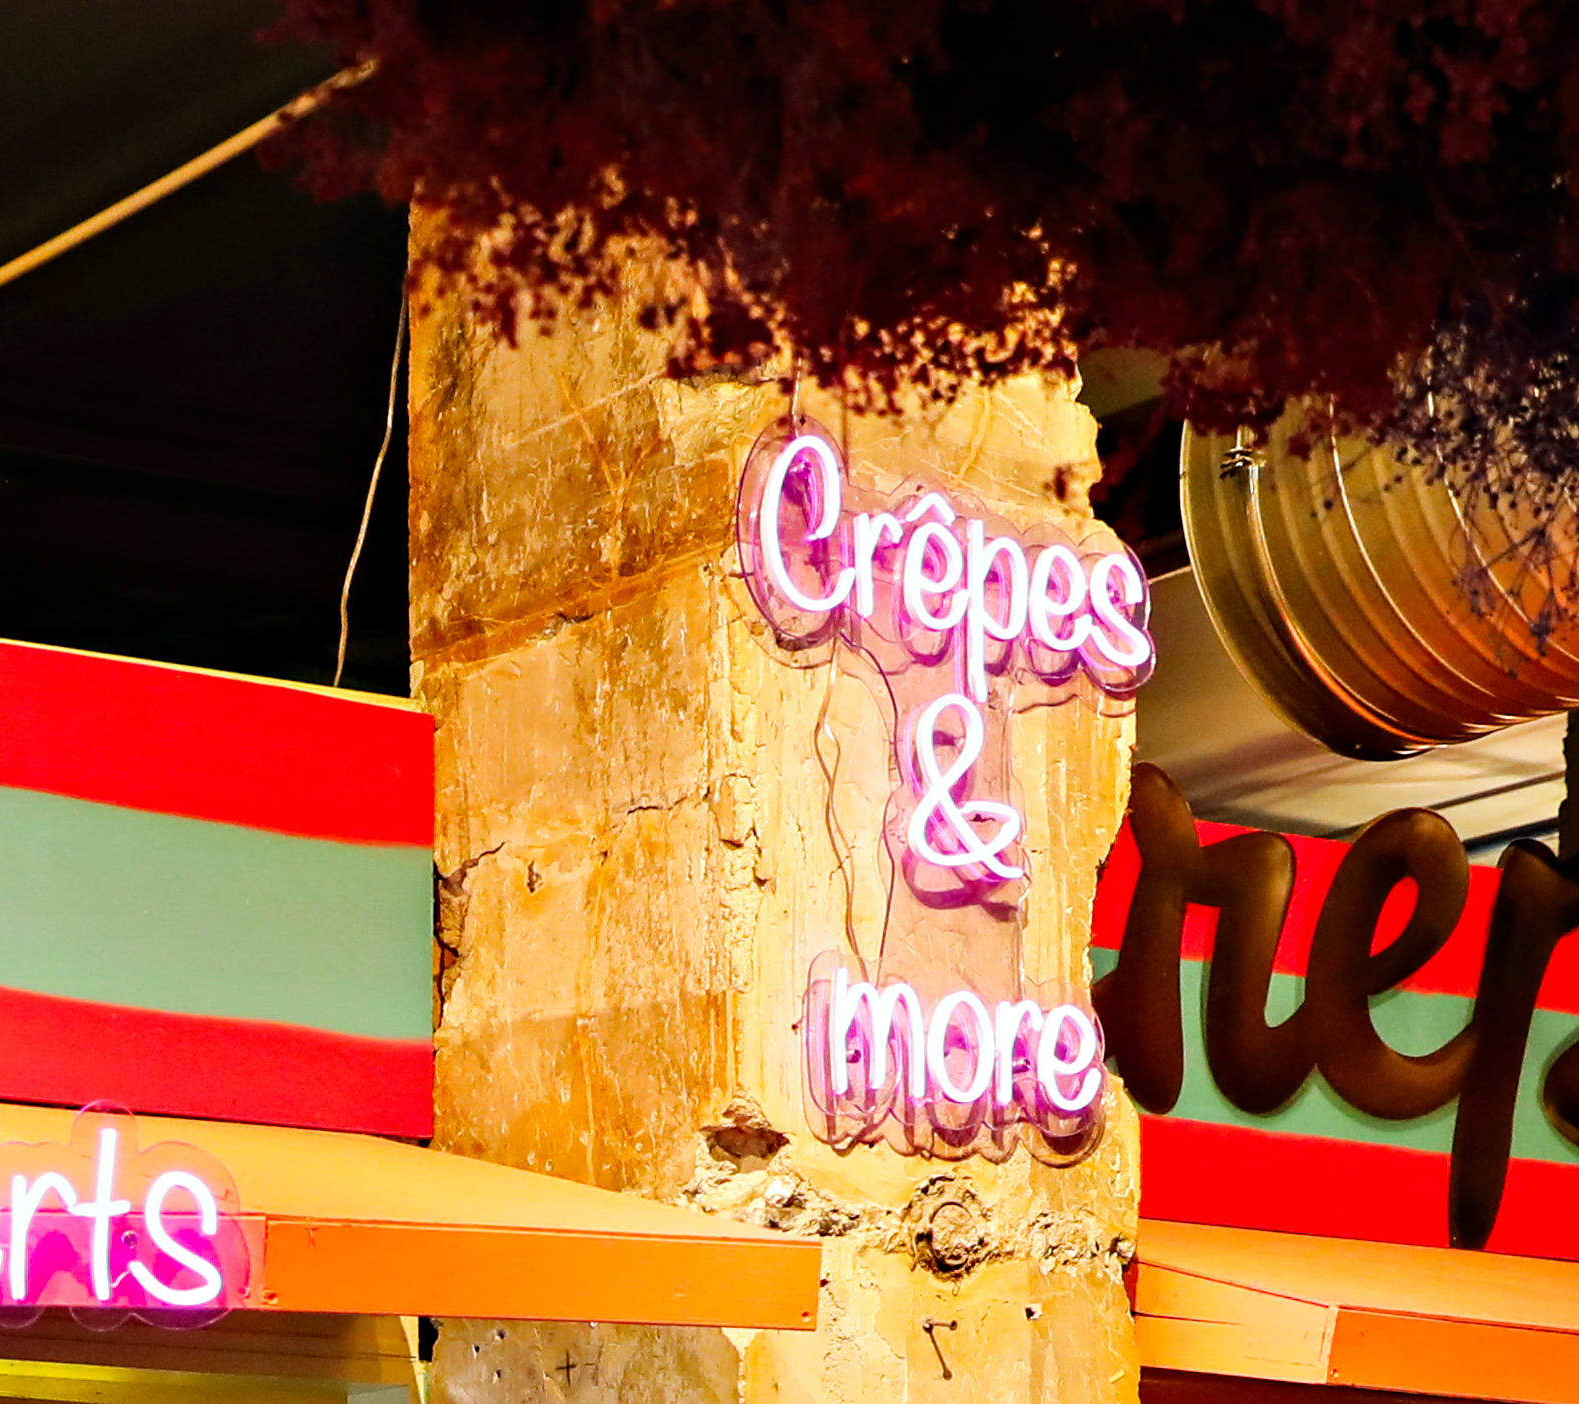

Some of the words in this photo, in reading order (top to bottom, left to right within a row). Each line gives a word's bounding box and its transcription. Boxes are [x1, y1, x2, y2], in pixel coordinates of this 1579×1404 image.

[755, 432, 1149, 704] Crêpes
[905, 691, 1025, 881] &
[829, 965, 1101, 1113] more
